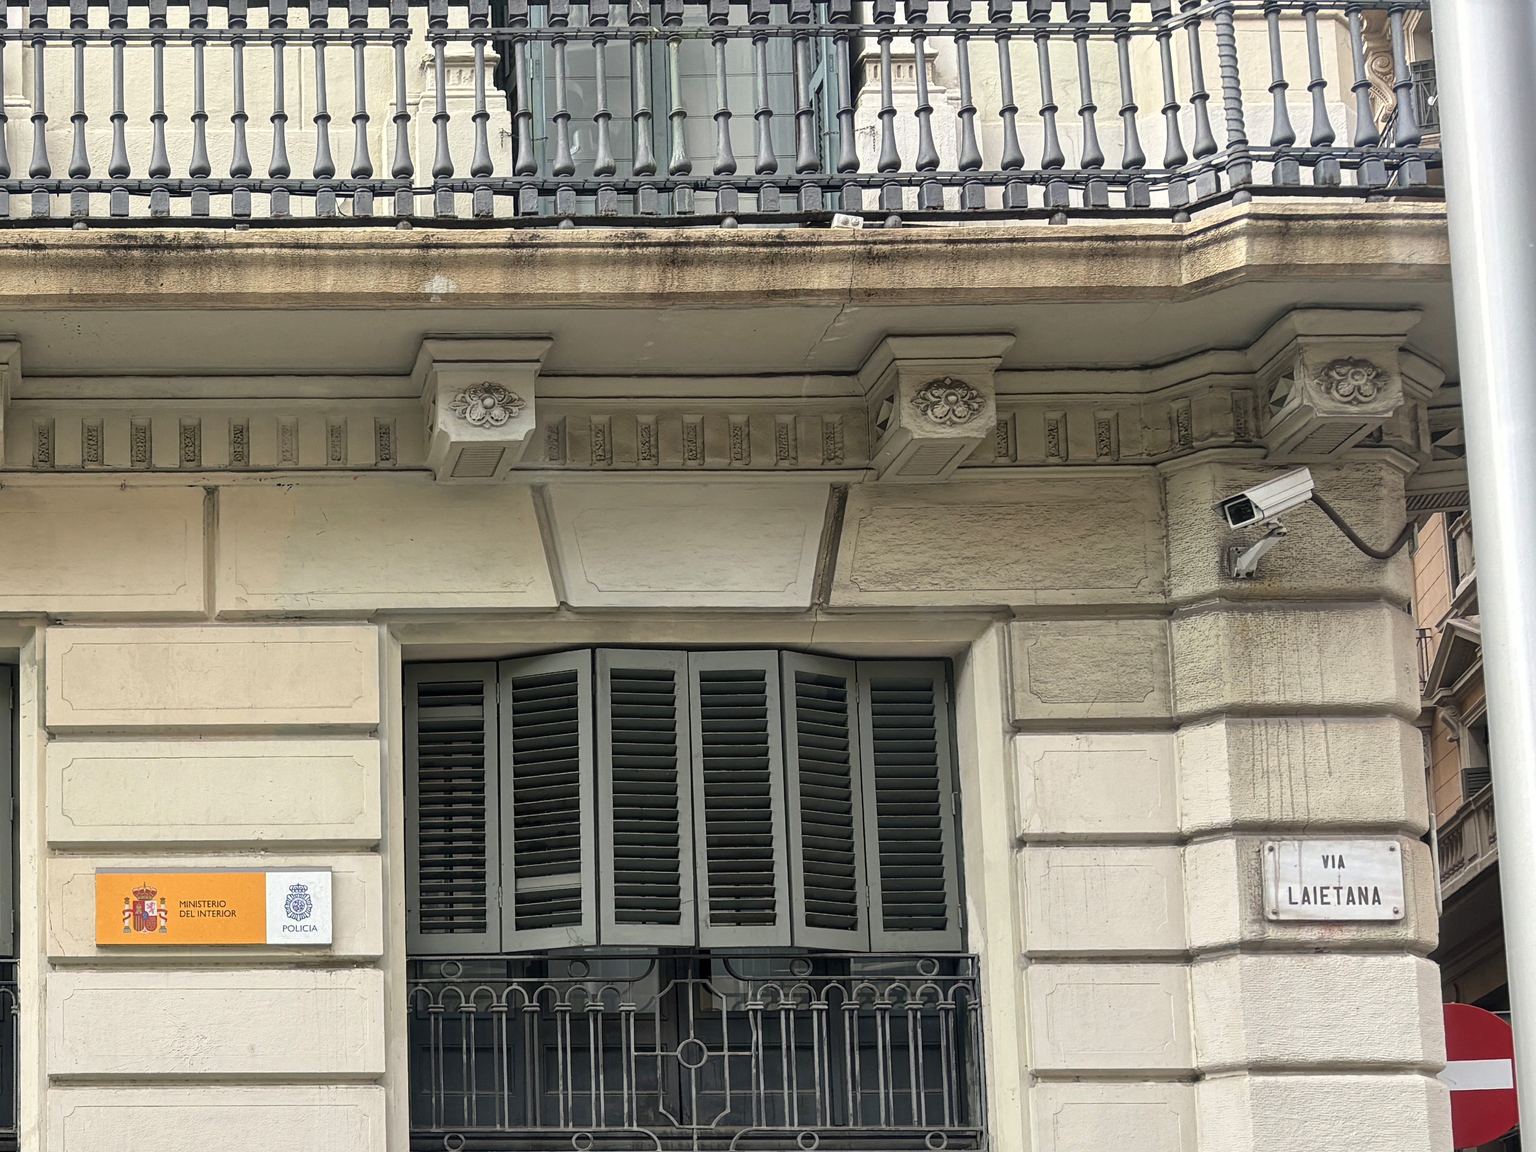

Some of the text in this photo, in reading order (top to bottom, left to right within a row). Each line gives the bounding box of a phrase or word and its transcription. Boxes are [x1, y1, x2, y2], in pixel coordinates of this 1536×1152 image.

[1321, 854, 1346, 869] VIA
[1288, 886, 1382, 906] LAIETANA
[179, 899, 227, 908] MINISTERIO
[179, 909, 237, 918] DEL INTERIOR
[282, 924, 318, 933] POLICIA
